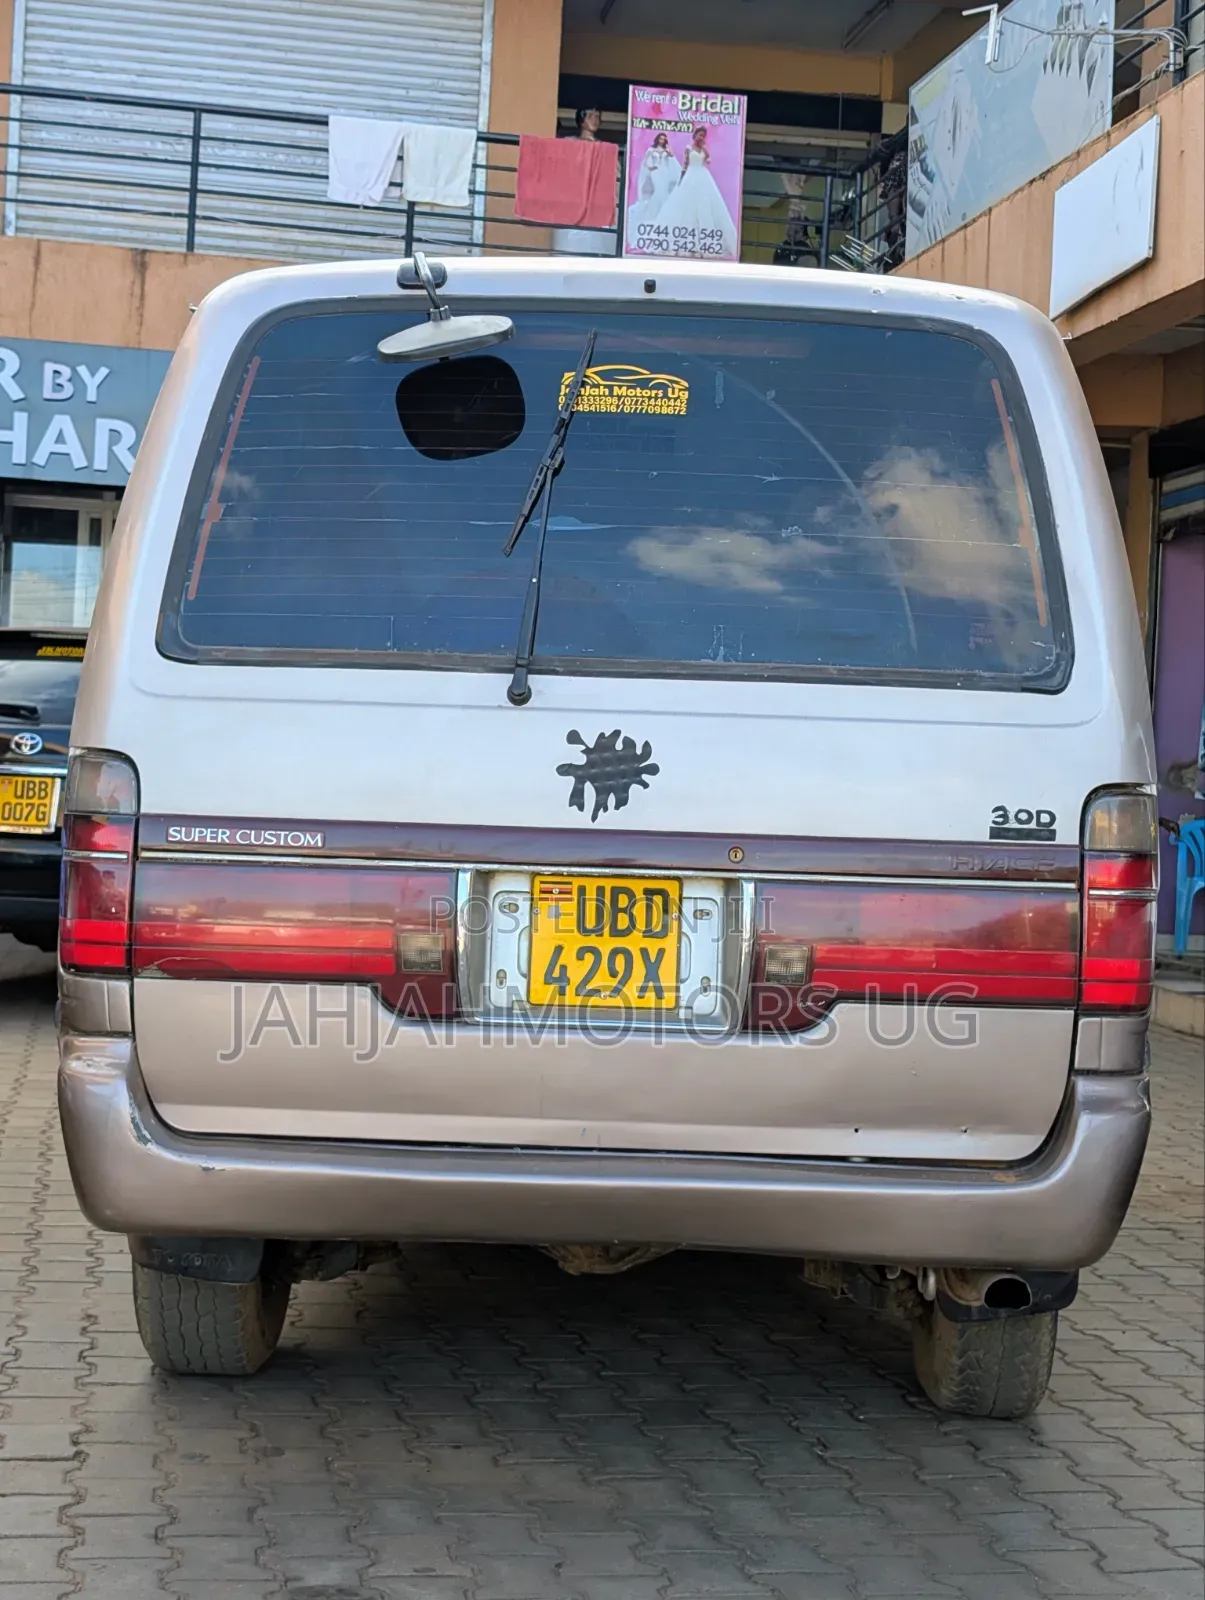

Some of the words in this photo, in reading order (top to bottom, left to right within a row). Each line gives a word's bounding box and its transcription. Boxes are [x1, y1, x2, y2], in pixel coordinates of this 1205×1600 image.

[634, 89, 650, 102] We
[651, 93, 669, 104] rent
[677, 91, 740, 114] Bridal
[678, 110, 719, 125] Wedding
[637, 223, 669, 237] 0744
[672, 226, 696, 240] 024
[699, 228, 723, 242] 549
[636, 237, 669, 251] 0790
[672, 240, 696, 253] 542
[699, 242, 723, 255] 462
[42, 361, 111, 404] BY
[613, 385, 664, 398] Motors
[667, 387, 689, 400] Ug
[558, 395, 687, 407] 01333296/0773440442
[14, 779, 49, 800] UBB
[1, 801, 48, 822] 007G
[168, 826, 230, 843] SUPER
[235, 829, 323, 848] CUSTOM
[576, 884, 670, 939] UBD
[543, 945, 666, 1000] 429X
